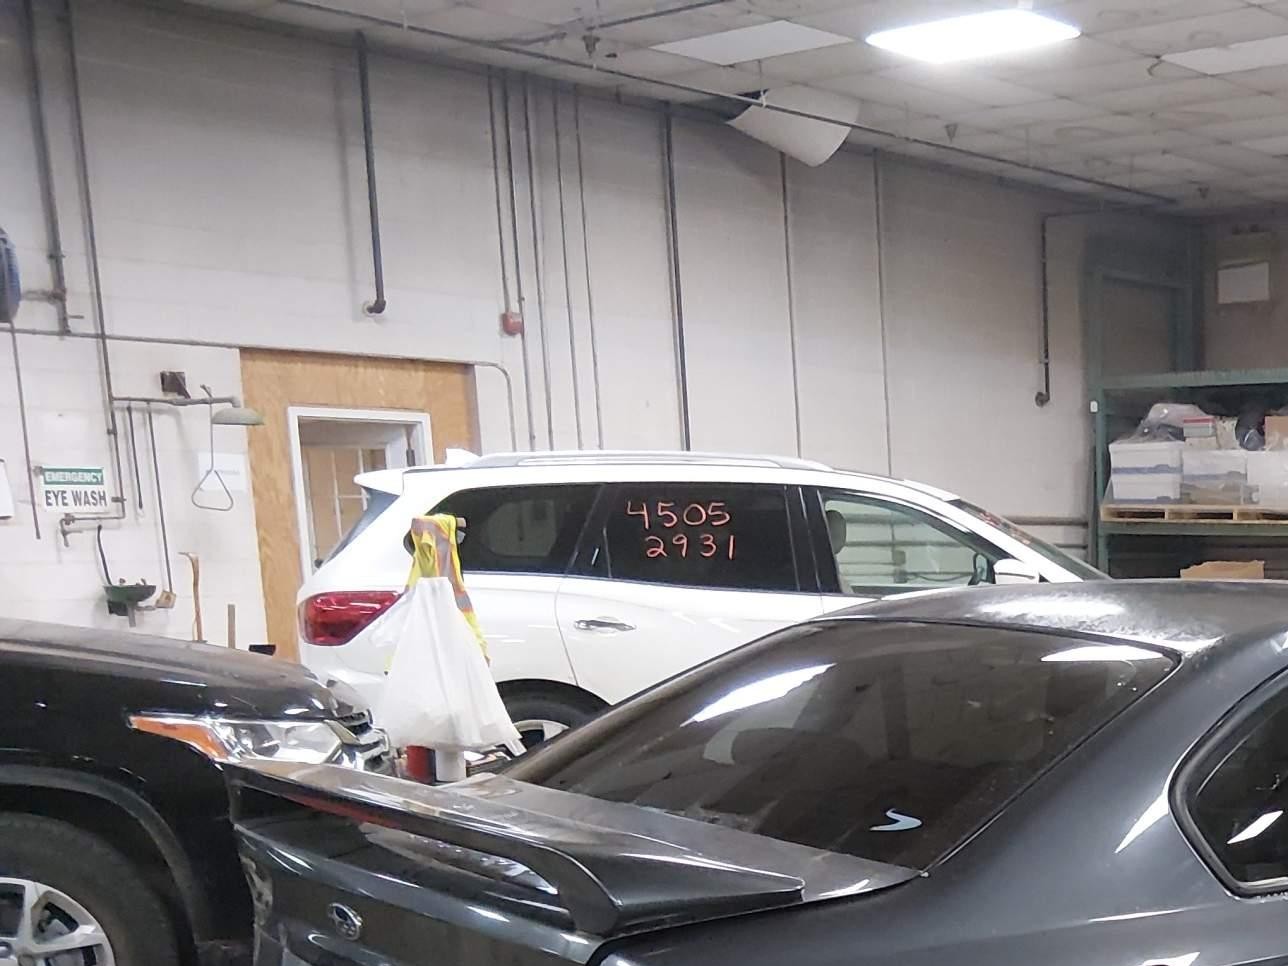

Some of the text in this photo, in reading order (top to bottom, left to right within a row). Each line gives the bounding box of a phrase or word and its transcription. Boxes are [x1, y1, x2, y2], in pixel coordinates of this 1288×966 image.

[45, 471, 103, 482] EMERGENCY
[45, 490, 107, 506] EYE WASH
[627, 501, 731, 529] 4505
[645, 534, 735, 560] 2931
